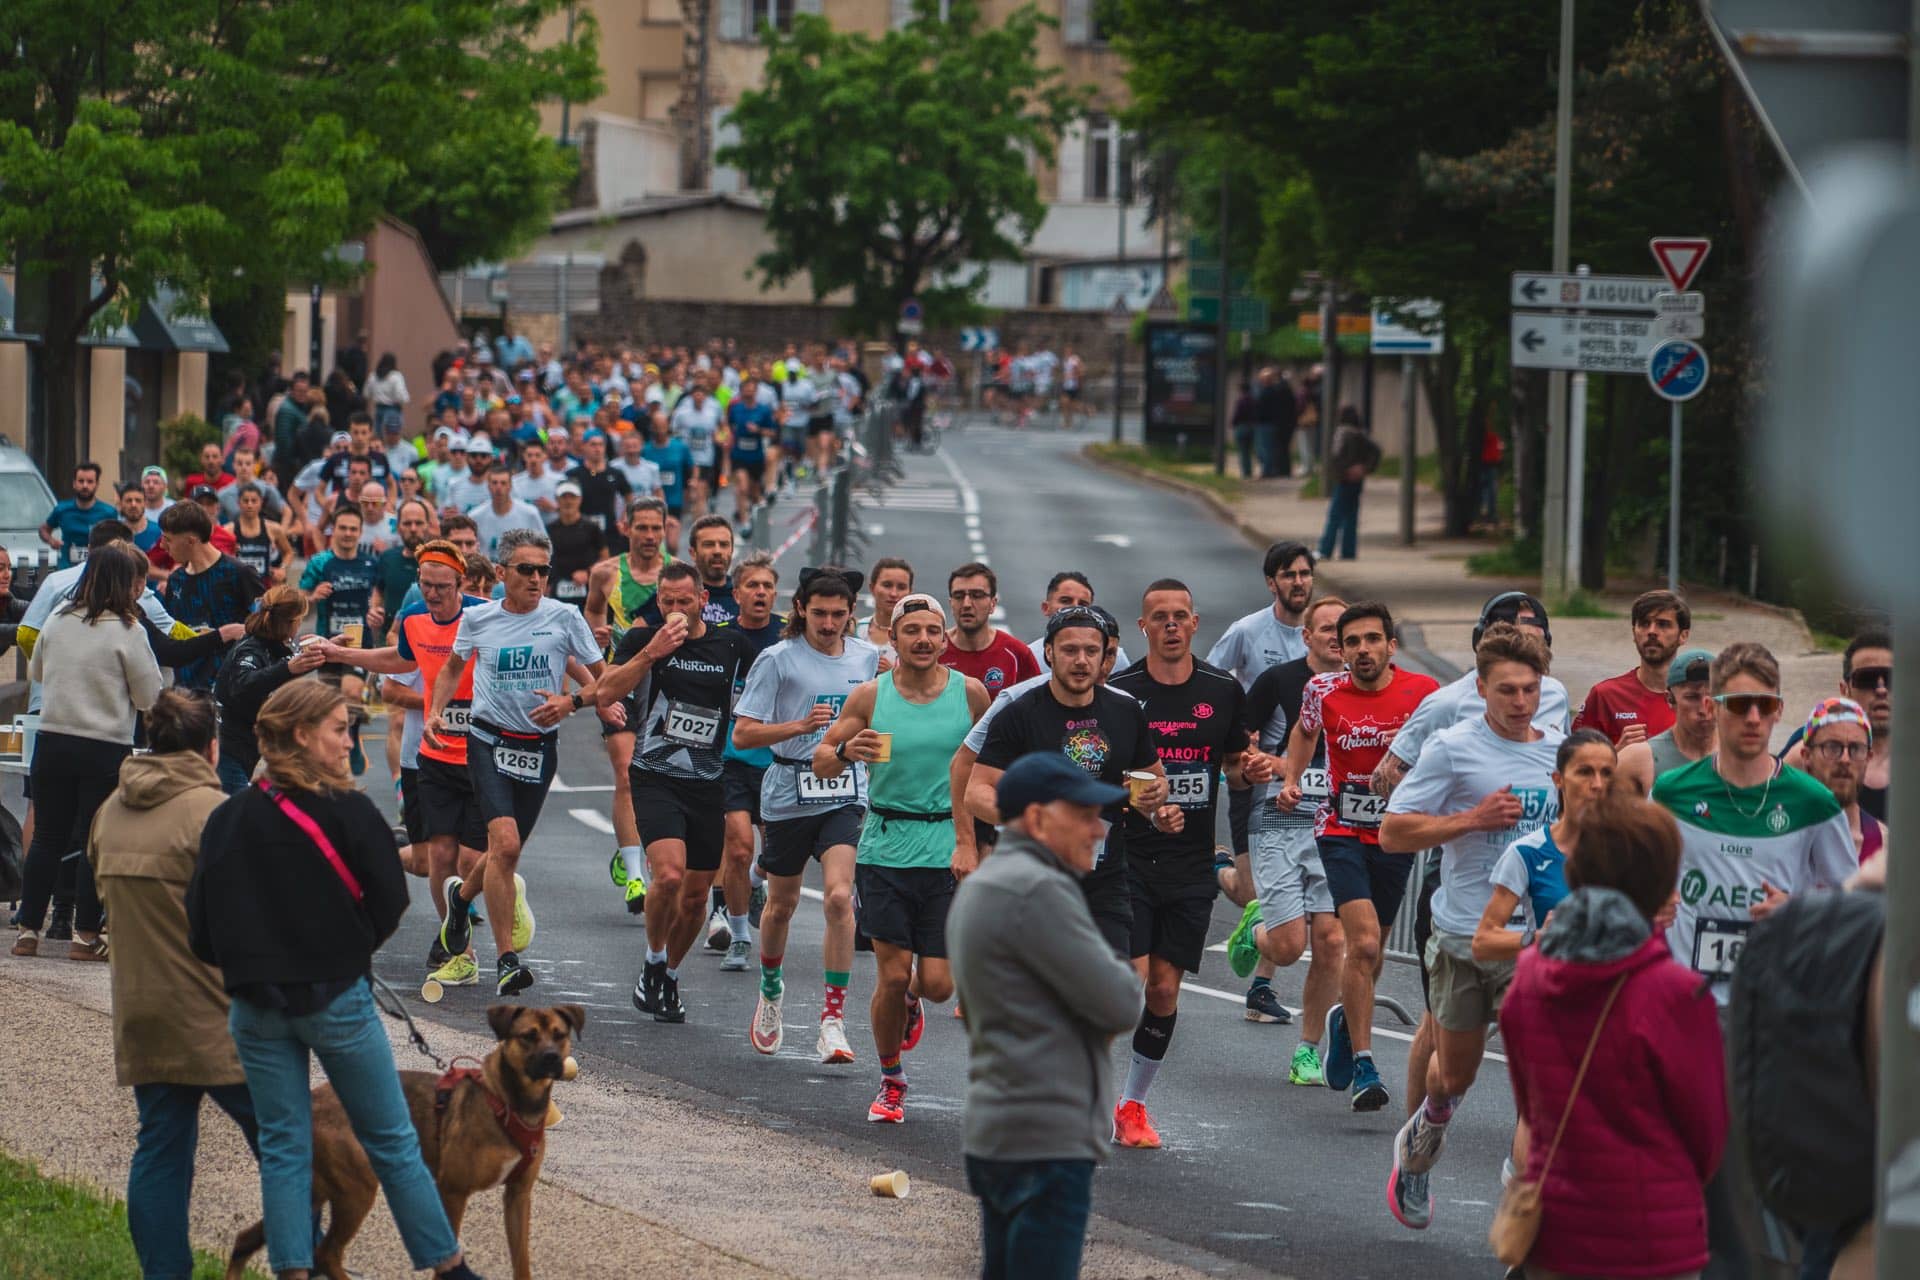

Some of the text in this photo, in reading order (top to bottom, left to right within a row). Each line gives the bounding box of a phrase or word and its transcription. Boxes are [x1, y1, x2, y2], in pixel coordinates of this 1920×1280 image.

[507, 648, 549, 670] 15 KM
[671, 715, 715, 737] 7027
[1337, 734, 1379, 750] Urban
[497, 751, 539, 770] 1263
[803, 774, 850, 790] 1167
[1303, 772, 1329, 788] 12
[1349, 798, 1389, 815] 742
[1519, 791, 1540, 817] 15
[1720, 843, 1753, 855] Loire
